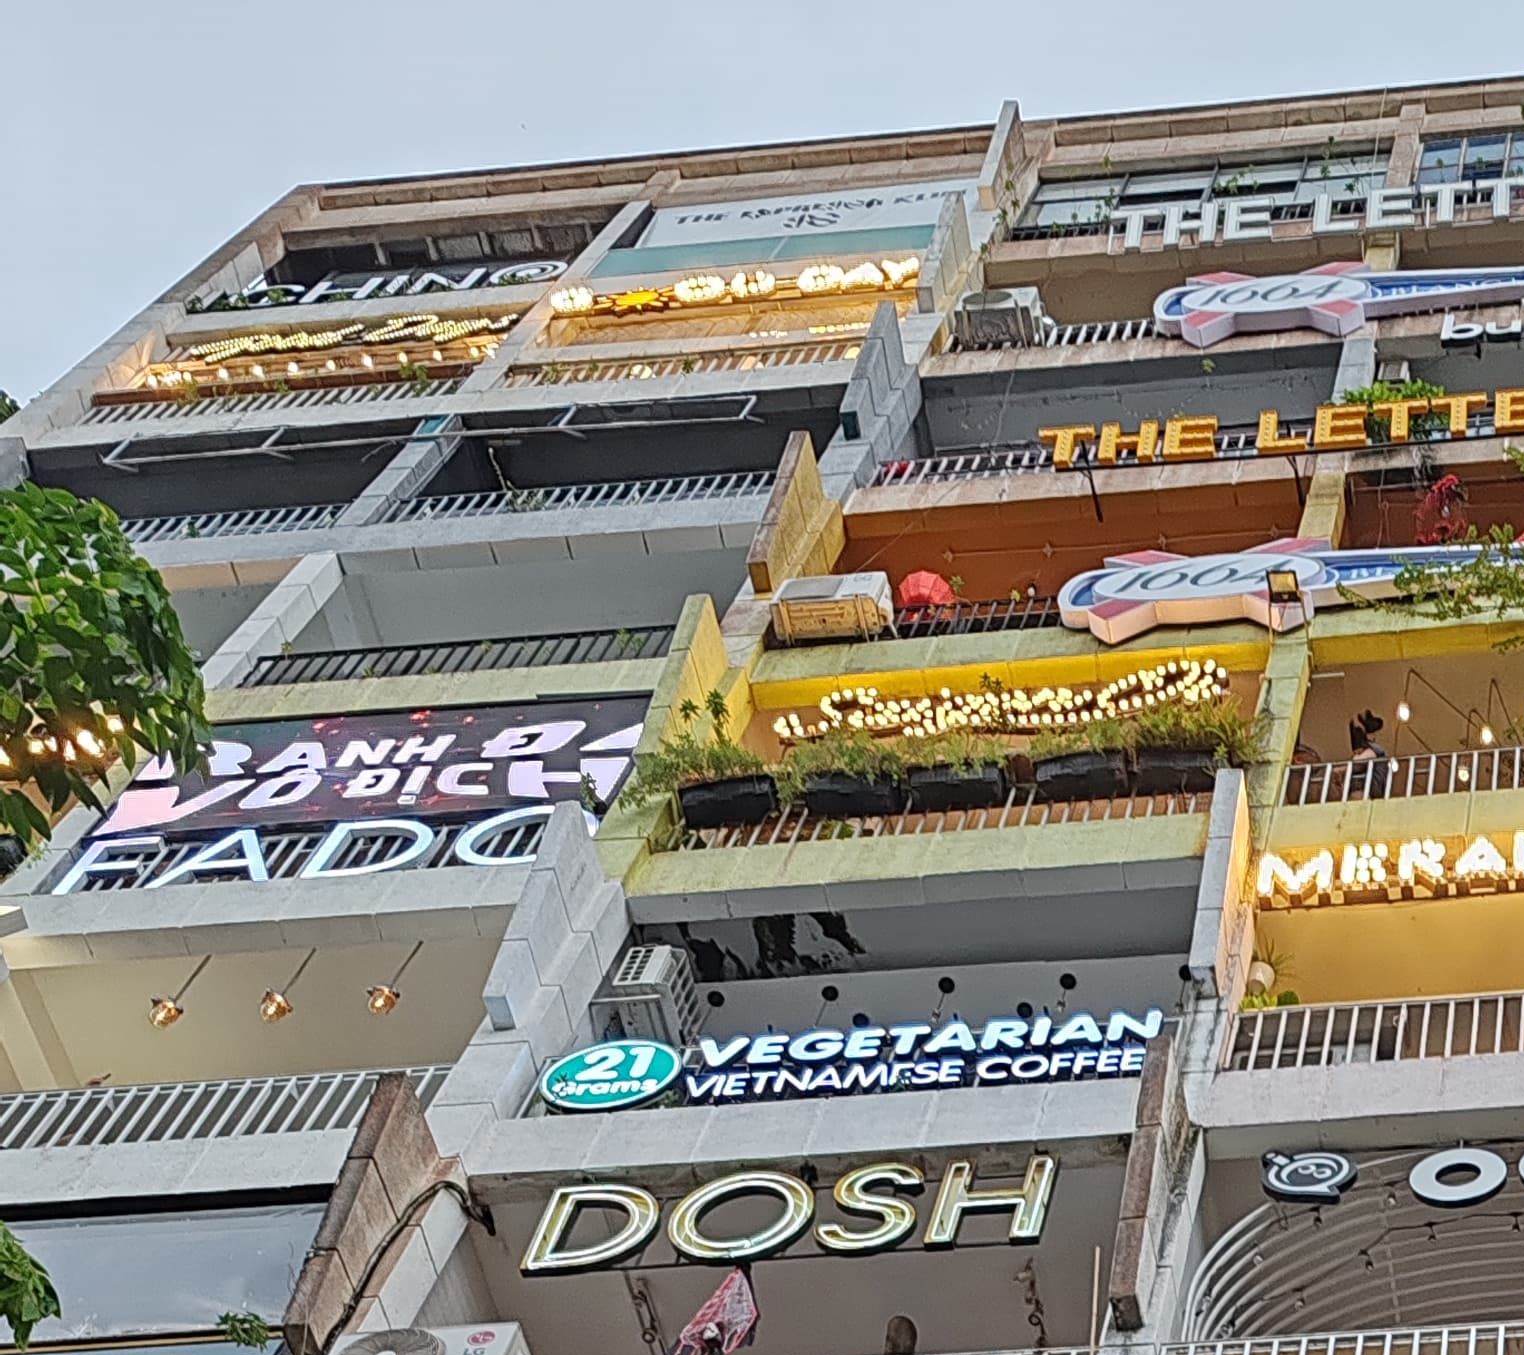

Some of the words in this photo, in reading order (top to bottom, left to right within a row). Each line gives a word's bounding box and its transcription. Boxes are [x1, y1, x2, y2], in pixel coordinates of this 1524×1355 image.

[1110, 196, 1276, 255] THE
[1200, 279, 1343, 307] 1664
[1039, 414, 1219, 470] THE
[575, 1046, 657, 1081] 21
[699, 1008, 1163, 1068] VEGETARIAN
[685, 1057, 962, 1099] VIETNAMESE
[975, 1045, 1148, 1083] COFFEE
[520, 1154, 1059, 1277] DOSH
